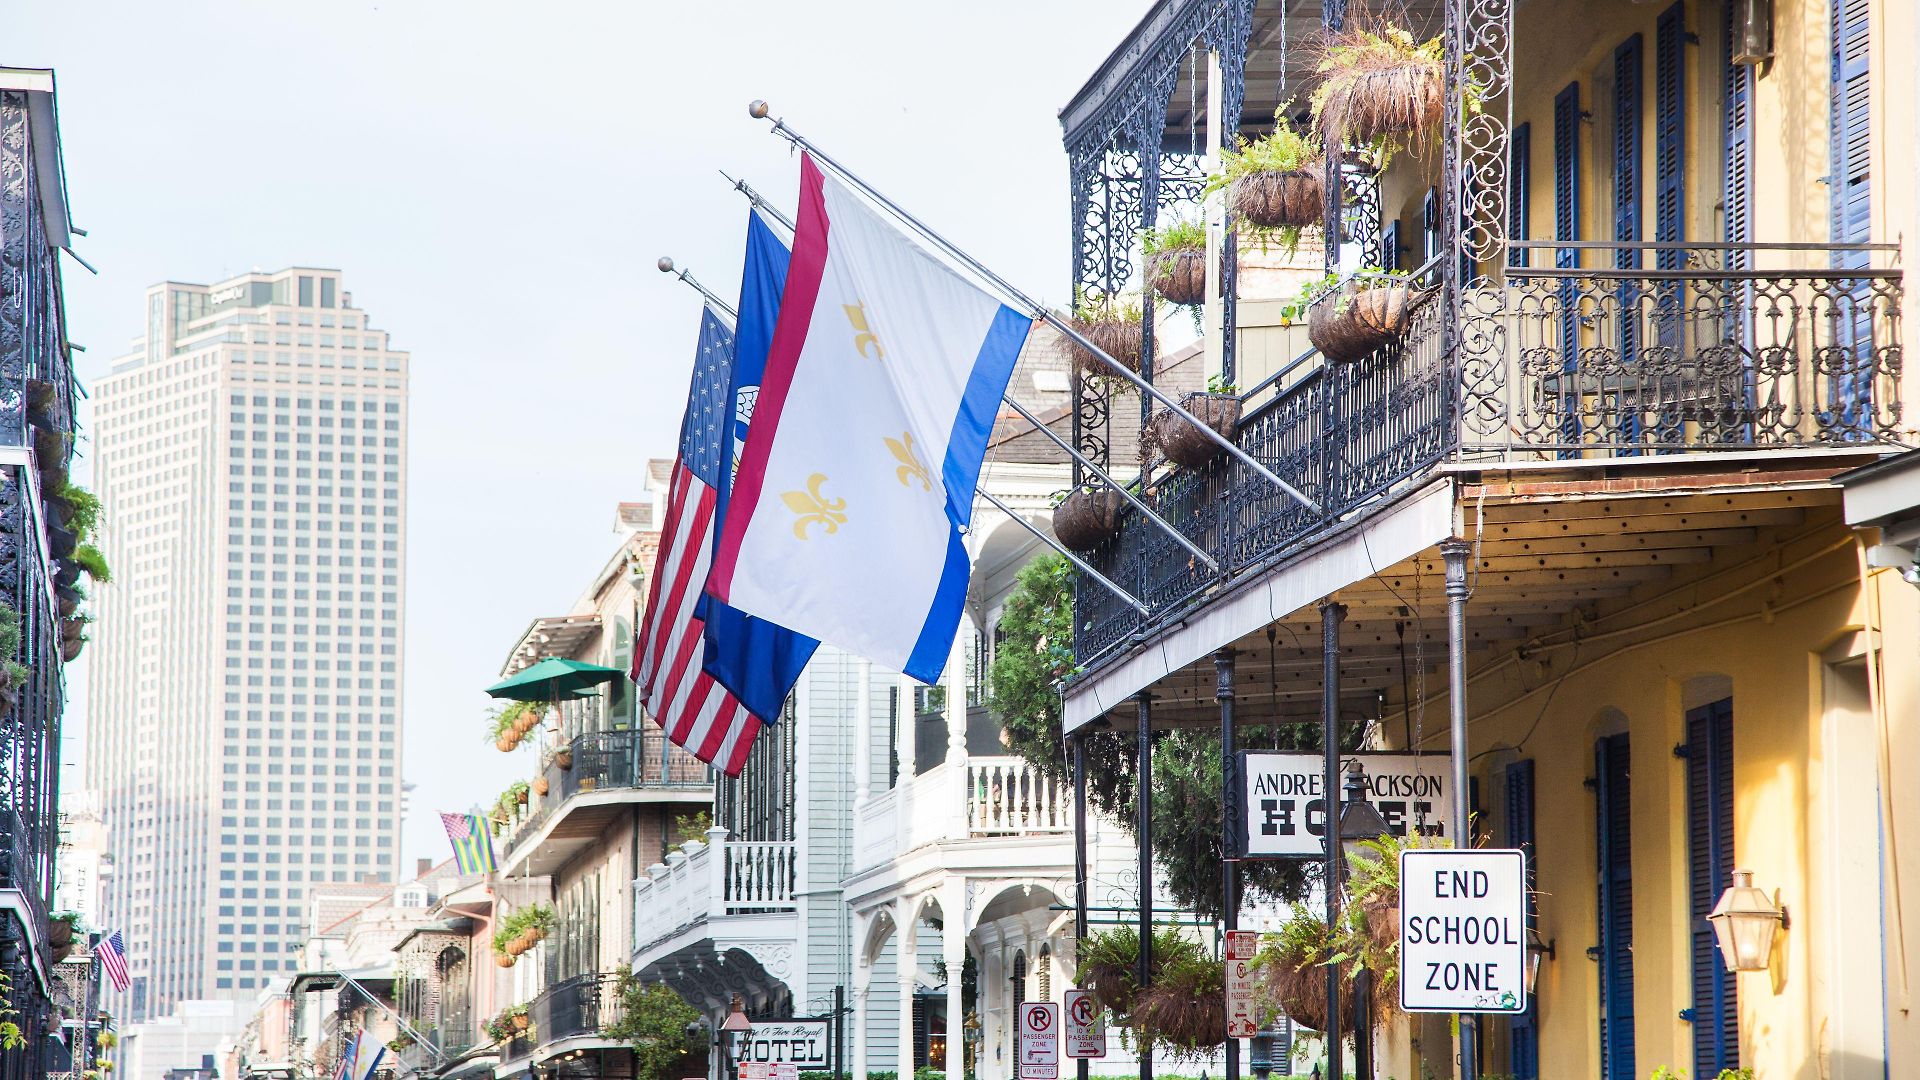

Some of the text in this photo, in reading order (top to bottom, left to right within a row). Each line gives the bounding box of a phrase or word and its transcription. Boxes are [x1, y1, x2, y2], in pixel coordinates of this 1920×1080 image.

[1361, 774, 1443, 798] ACKSON
[1260, 799, 1445, 837] HOEL
[1435, 870, 1489, 898] END
[1408, 916, 1518, 945] SCHOOL
[1425, 962, 1499, 991] ZONE
[792, 1025, 824, 1039] Royal
[736, 1039, 824, 1063] HOTEL
[1032, 1068, 1054, 1076] MINUTES
